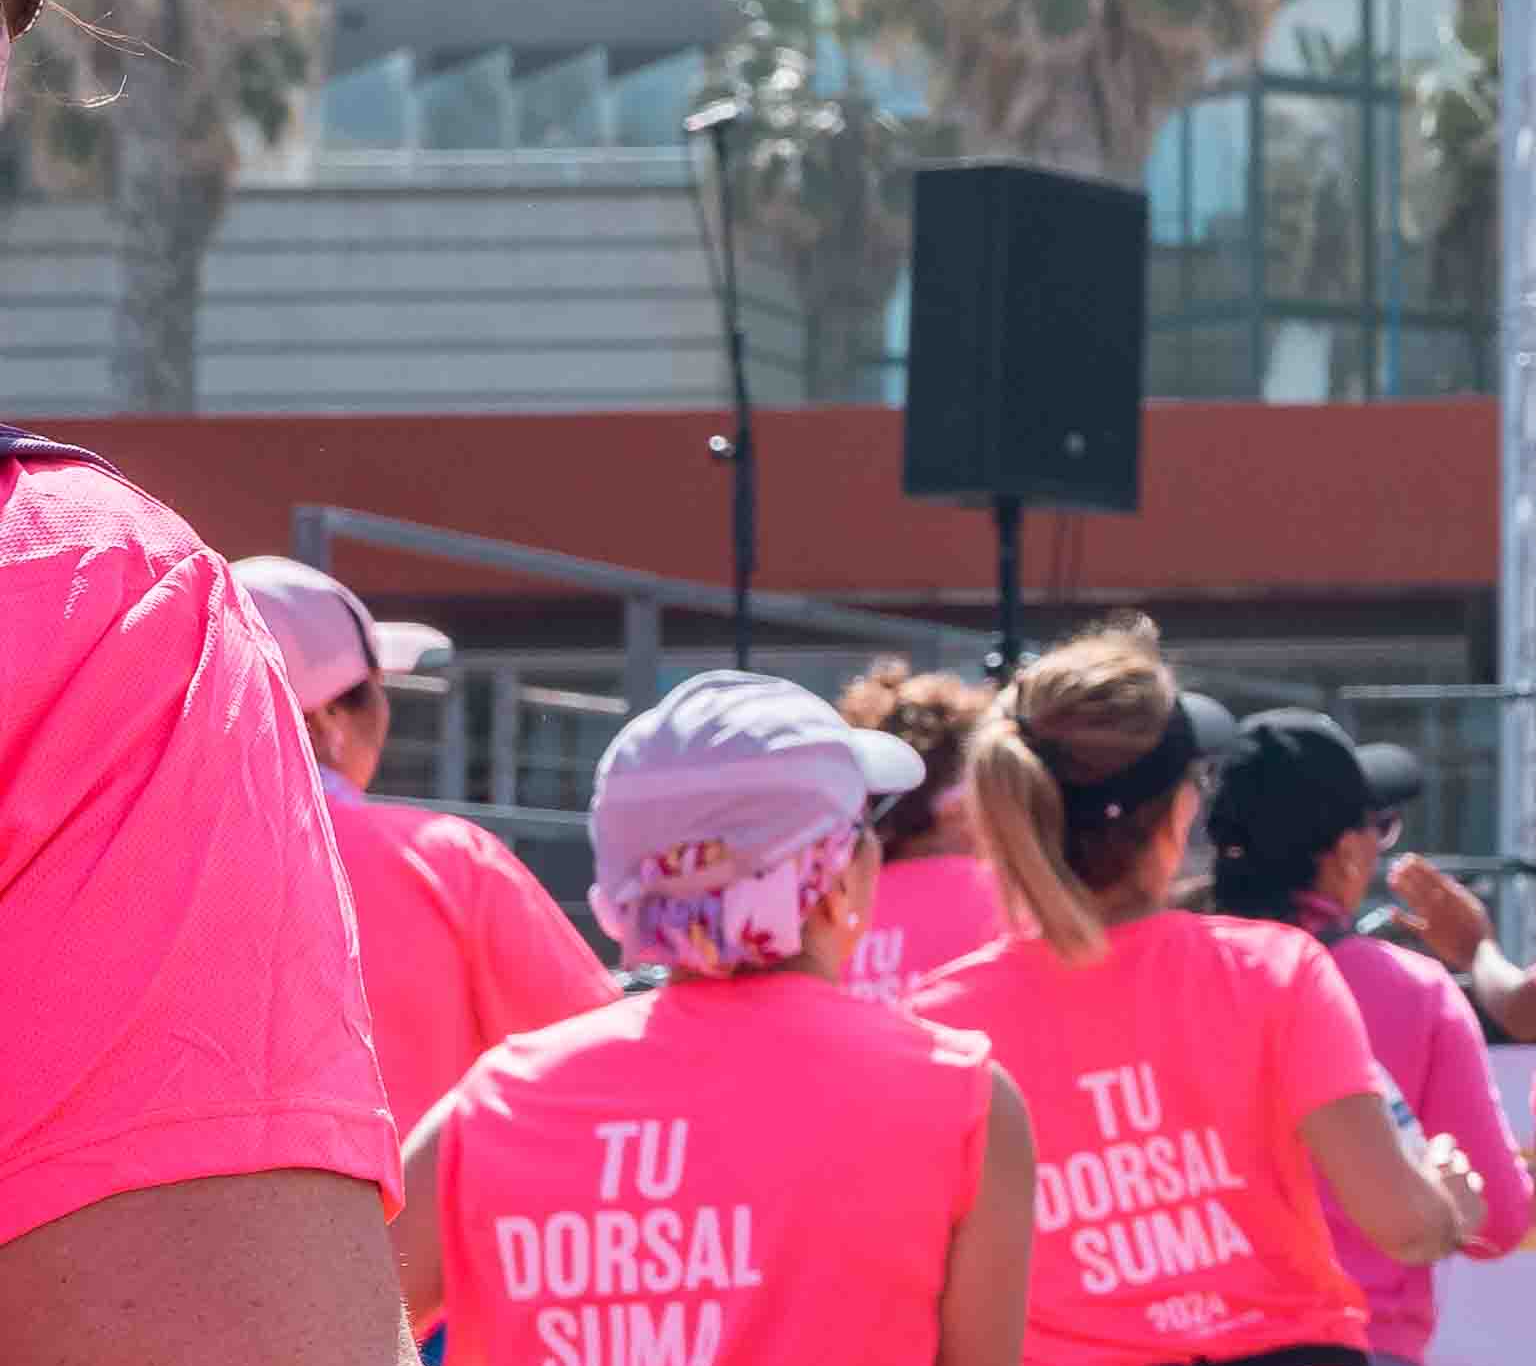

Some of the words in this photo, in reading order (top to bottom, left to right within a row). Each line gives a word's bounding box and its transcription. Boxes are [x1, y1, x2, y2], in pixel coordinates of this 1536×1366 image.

[1076, 1061, 1163, 1140] TU
[594, 1118, 689, 1202] TU
[1033, 1127, 1250, 1233] DORSAL
[495, 1203, 764, 1302] DORSAL
[1071, 1197, 1254, 1296] SUMA
